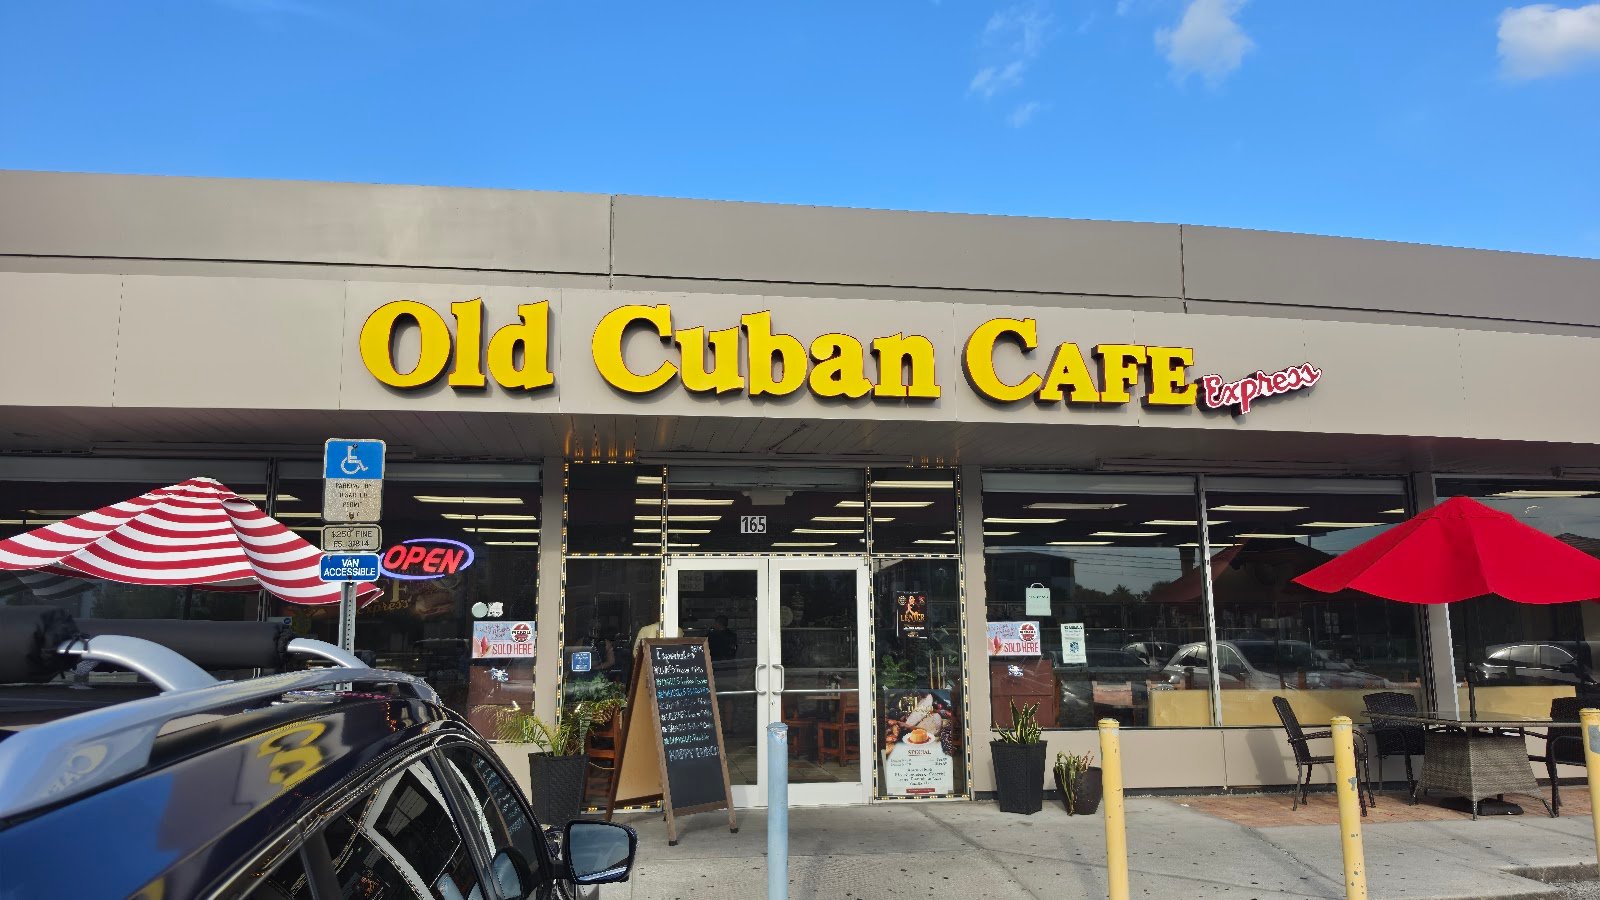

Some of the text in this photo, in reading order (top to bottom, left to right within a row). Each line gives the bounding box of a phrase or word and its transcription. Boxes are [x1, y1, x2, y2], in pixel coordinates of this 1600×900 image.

[359, 298, 1199, 406] Old Cuban CAFE
[1203, 362, 1323, 414] Express
[741, 516, 766, 532] 165
[331, 530, 373, 538] $250 FINE
[341, 558, 360, 567] VAN
[383, 545, 464, 574] OPEN
[323, 567, 377, 577] ACCESSIBLE
[491, 643, 533, 655] SOLD HERE
[1004, 642, 1039, 652] SOLD HERE
